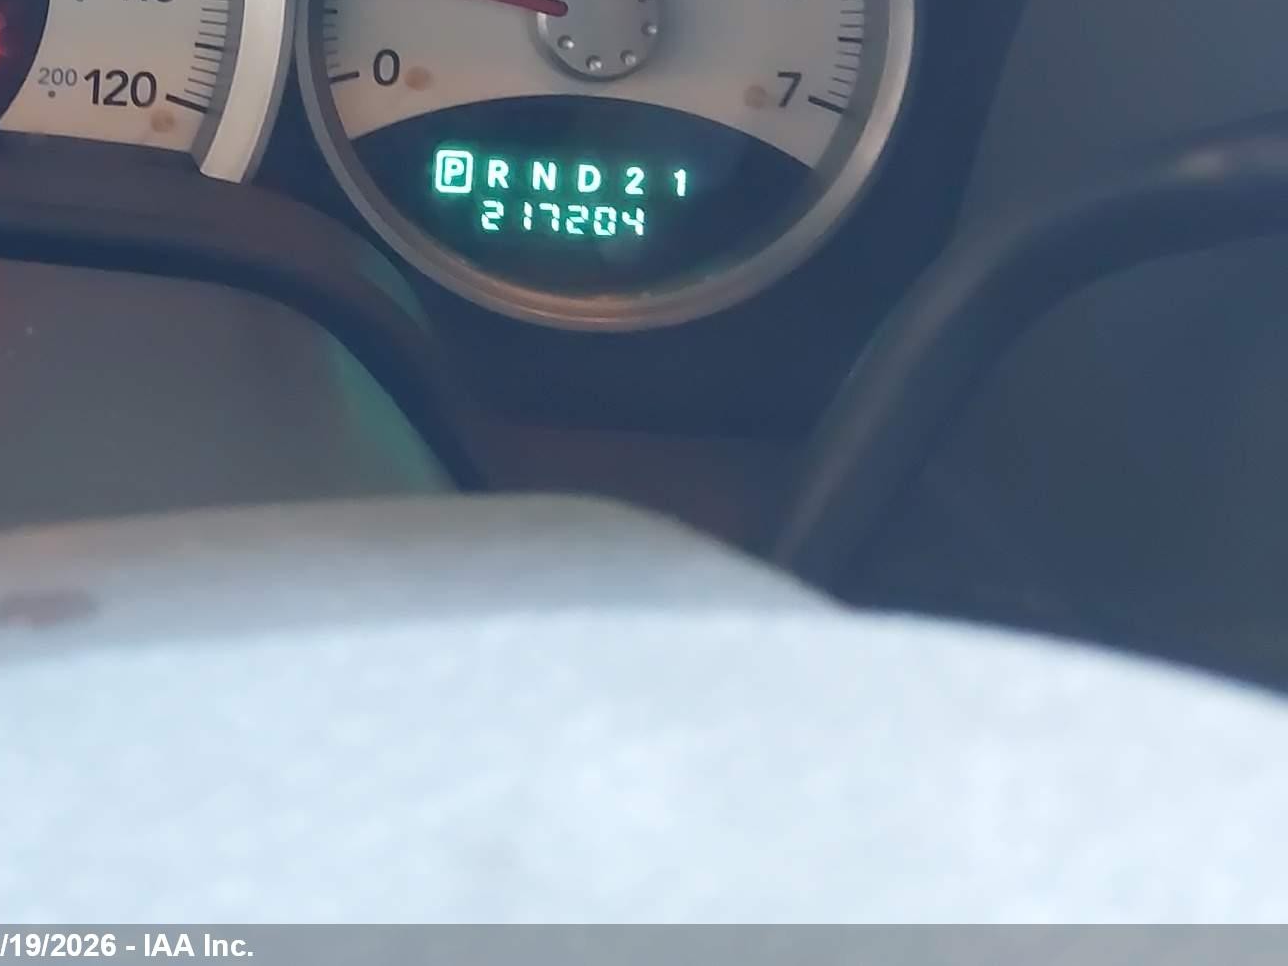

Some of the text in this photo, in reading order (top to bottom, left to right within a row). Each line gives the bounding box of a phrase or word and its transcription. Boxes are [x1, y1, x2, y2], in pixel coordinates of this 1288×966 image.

[38, 68, 77, 87] 200
[372, 49, 401, 87] 0
[83, 69, 157, 109] 120
[776, 72, 803, 109] 7
[487, 160, 510, 189] R
[532, 163, 556, 191] N
[578, 165, 602, 192] D
[625, 167, 644, 195] 2
[673, 169, 687, 197] 1
[481, 200, 646, 236] 217204
